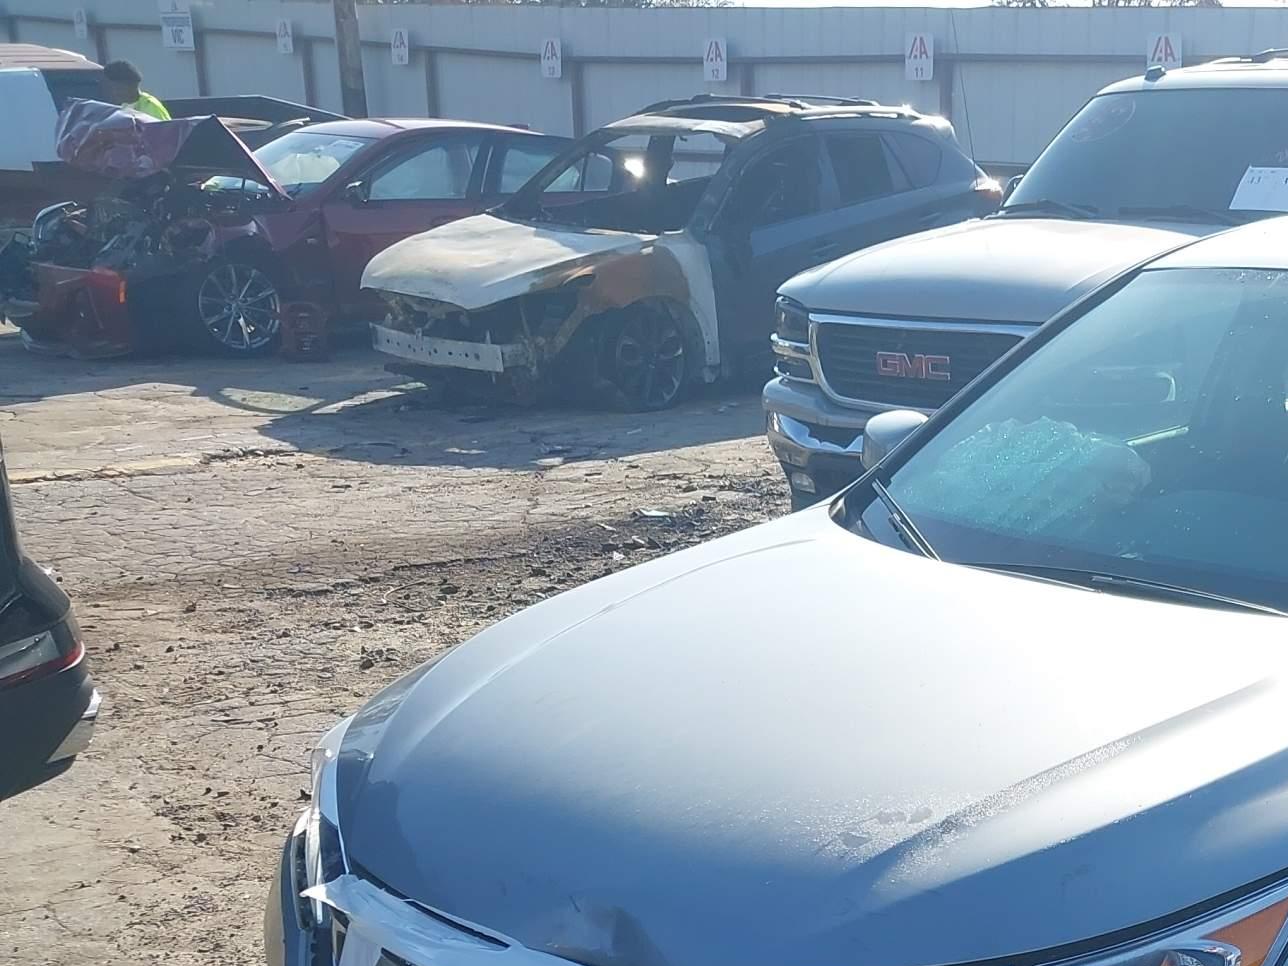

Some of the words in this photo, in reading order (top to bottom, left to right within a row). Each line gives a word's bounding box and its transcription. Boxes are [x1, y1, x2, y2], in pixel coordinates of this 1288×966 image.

[711, 68, 720, 79] 12
[914, 67, 924, 78] 11
[876, 351, 950, 380] GMC
